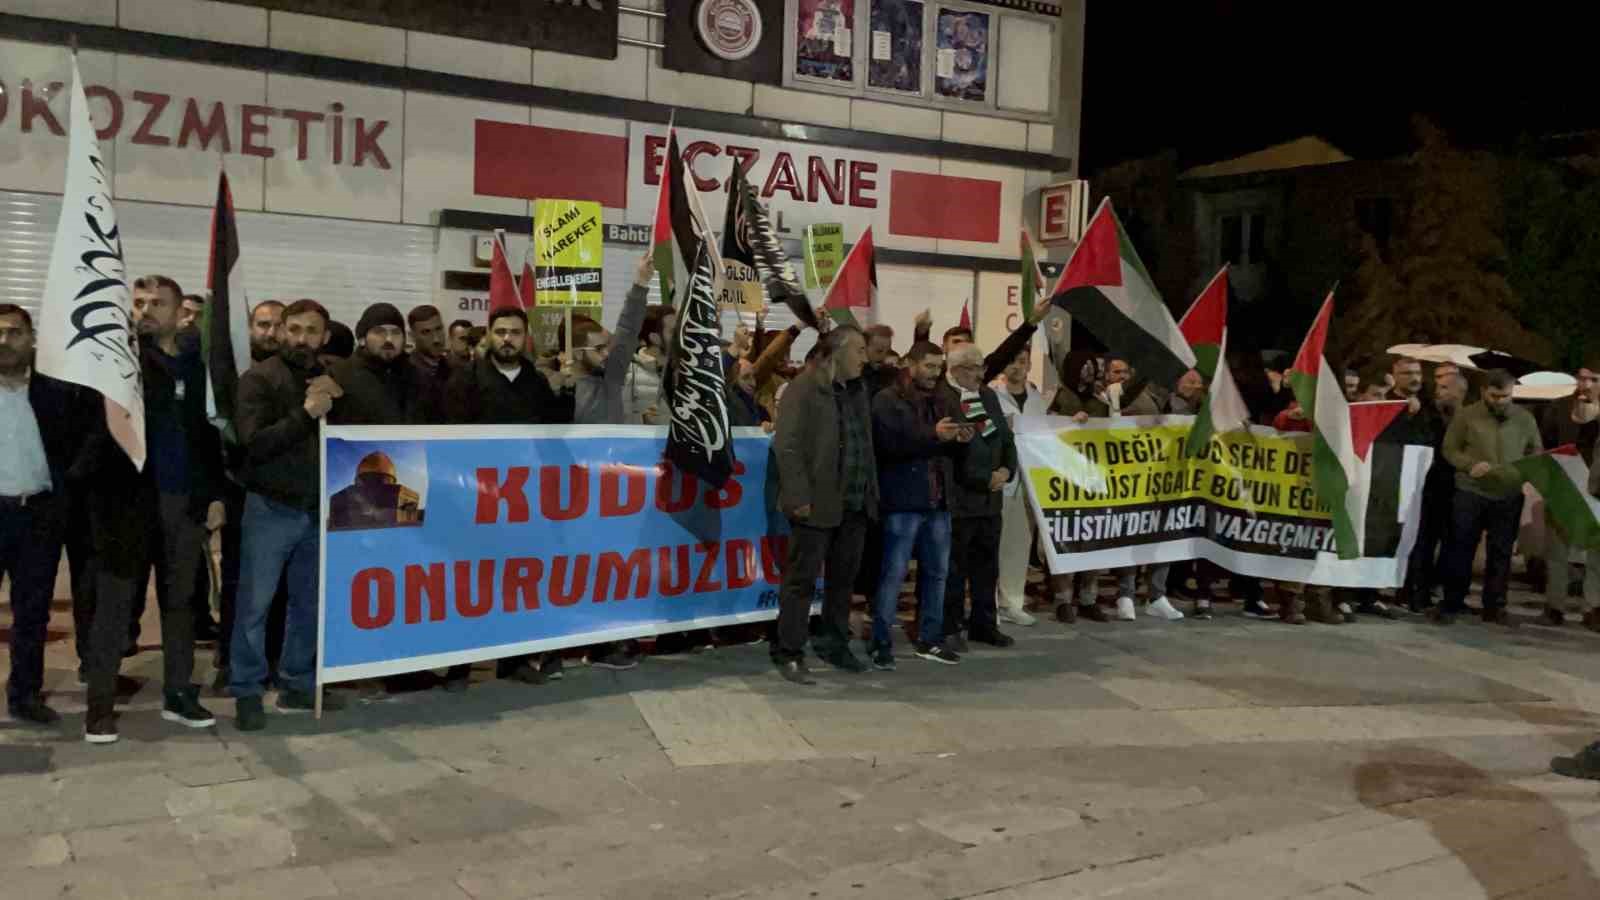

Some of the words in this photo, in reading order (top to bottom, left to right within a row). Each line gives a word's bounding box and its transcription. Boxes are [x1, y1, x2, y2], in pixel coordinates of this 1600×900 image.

[643, 134, 878, 209] ECZANE
[1046, 194, 1066, 234] E
[1229, 443, 1278, 473] SENE
[1210, 474, 1281, 508] BOYUN
[1164, 504, 1207, 535] ASLA
